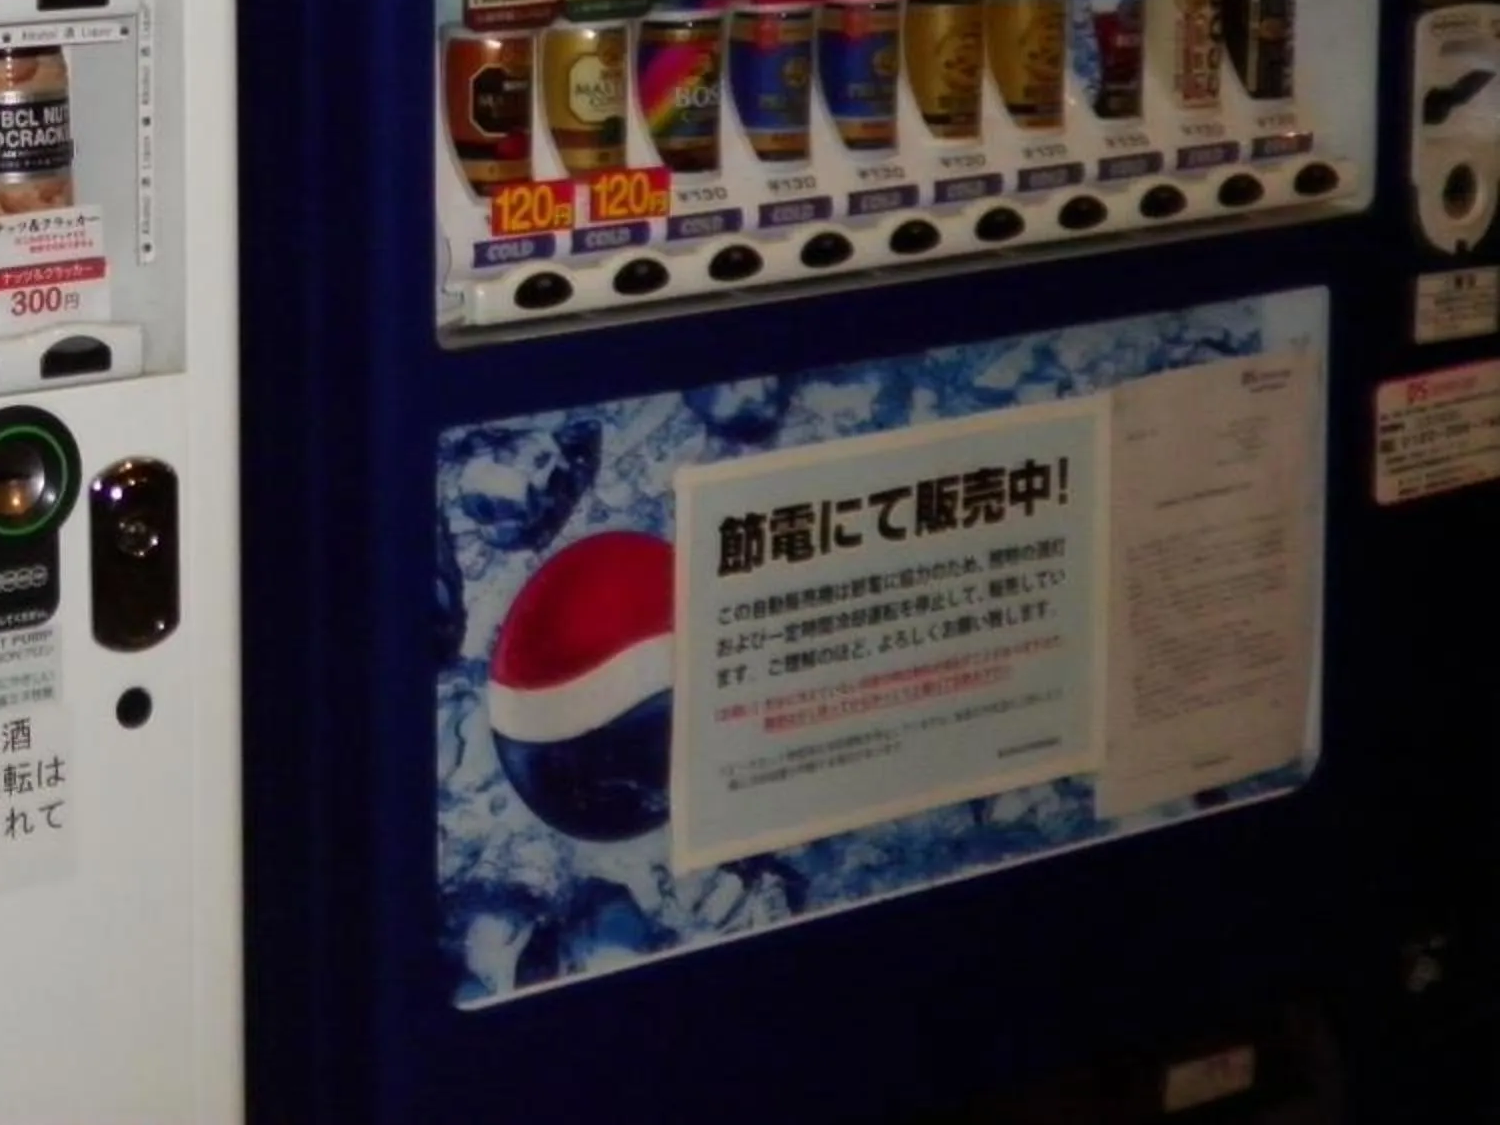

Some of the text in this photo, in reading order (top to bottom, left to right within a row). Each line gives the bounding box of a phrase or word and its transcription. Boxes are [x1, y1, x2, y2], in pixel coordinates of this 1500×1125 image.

[496, 184, 572, 232] 120円
[594, 172, 667, 219] 120円
[485, 241, 534, 262] COLD
[585, 227, 630, 248] COLD
[10, 286, 80, 317] 300円
[716, 456, 1070, 579] 節電にて販売中!
